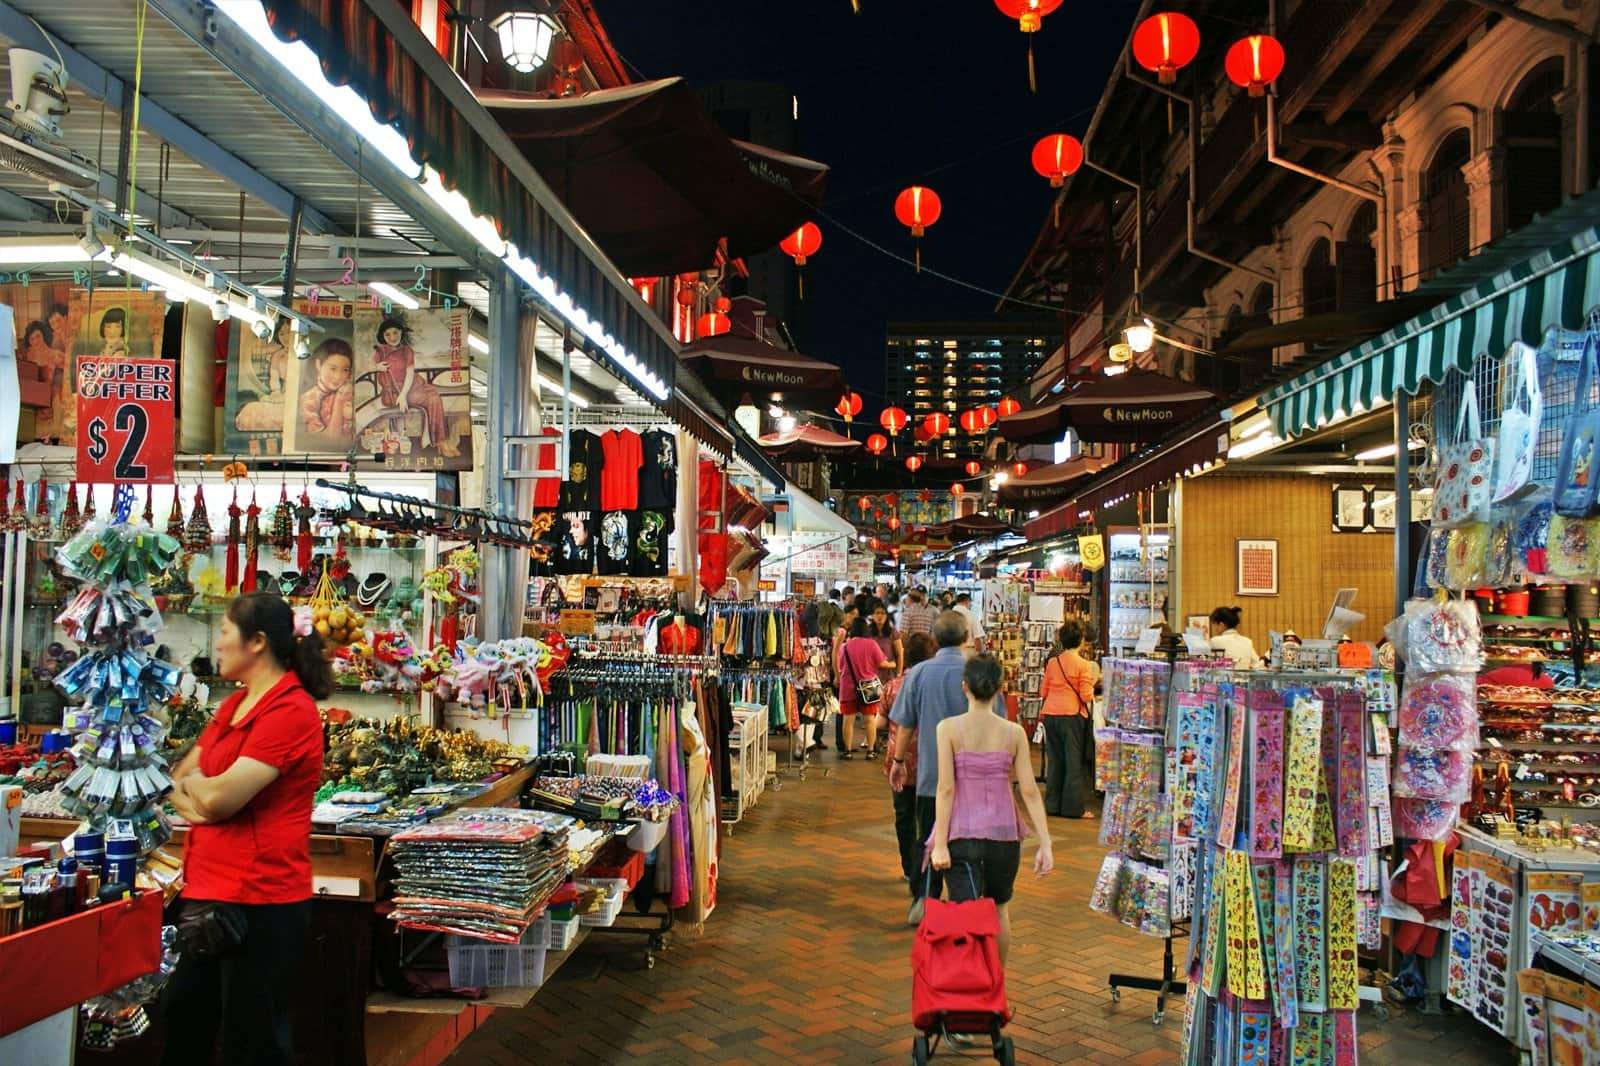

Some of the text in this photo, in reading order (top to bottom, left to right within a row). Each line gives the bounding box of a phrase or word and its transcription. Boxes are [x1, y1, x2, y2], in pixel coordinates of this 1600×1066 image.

[80, 362, 172, 382] SUPER
[80, 382, 172, 401] OFFER
[1115, 407, 1174, 423] NewMoon
